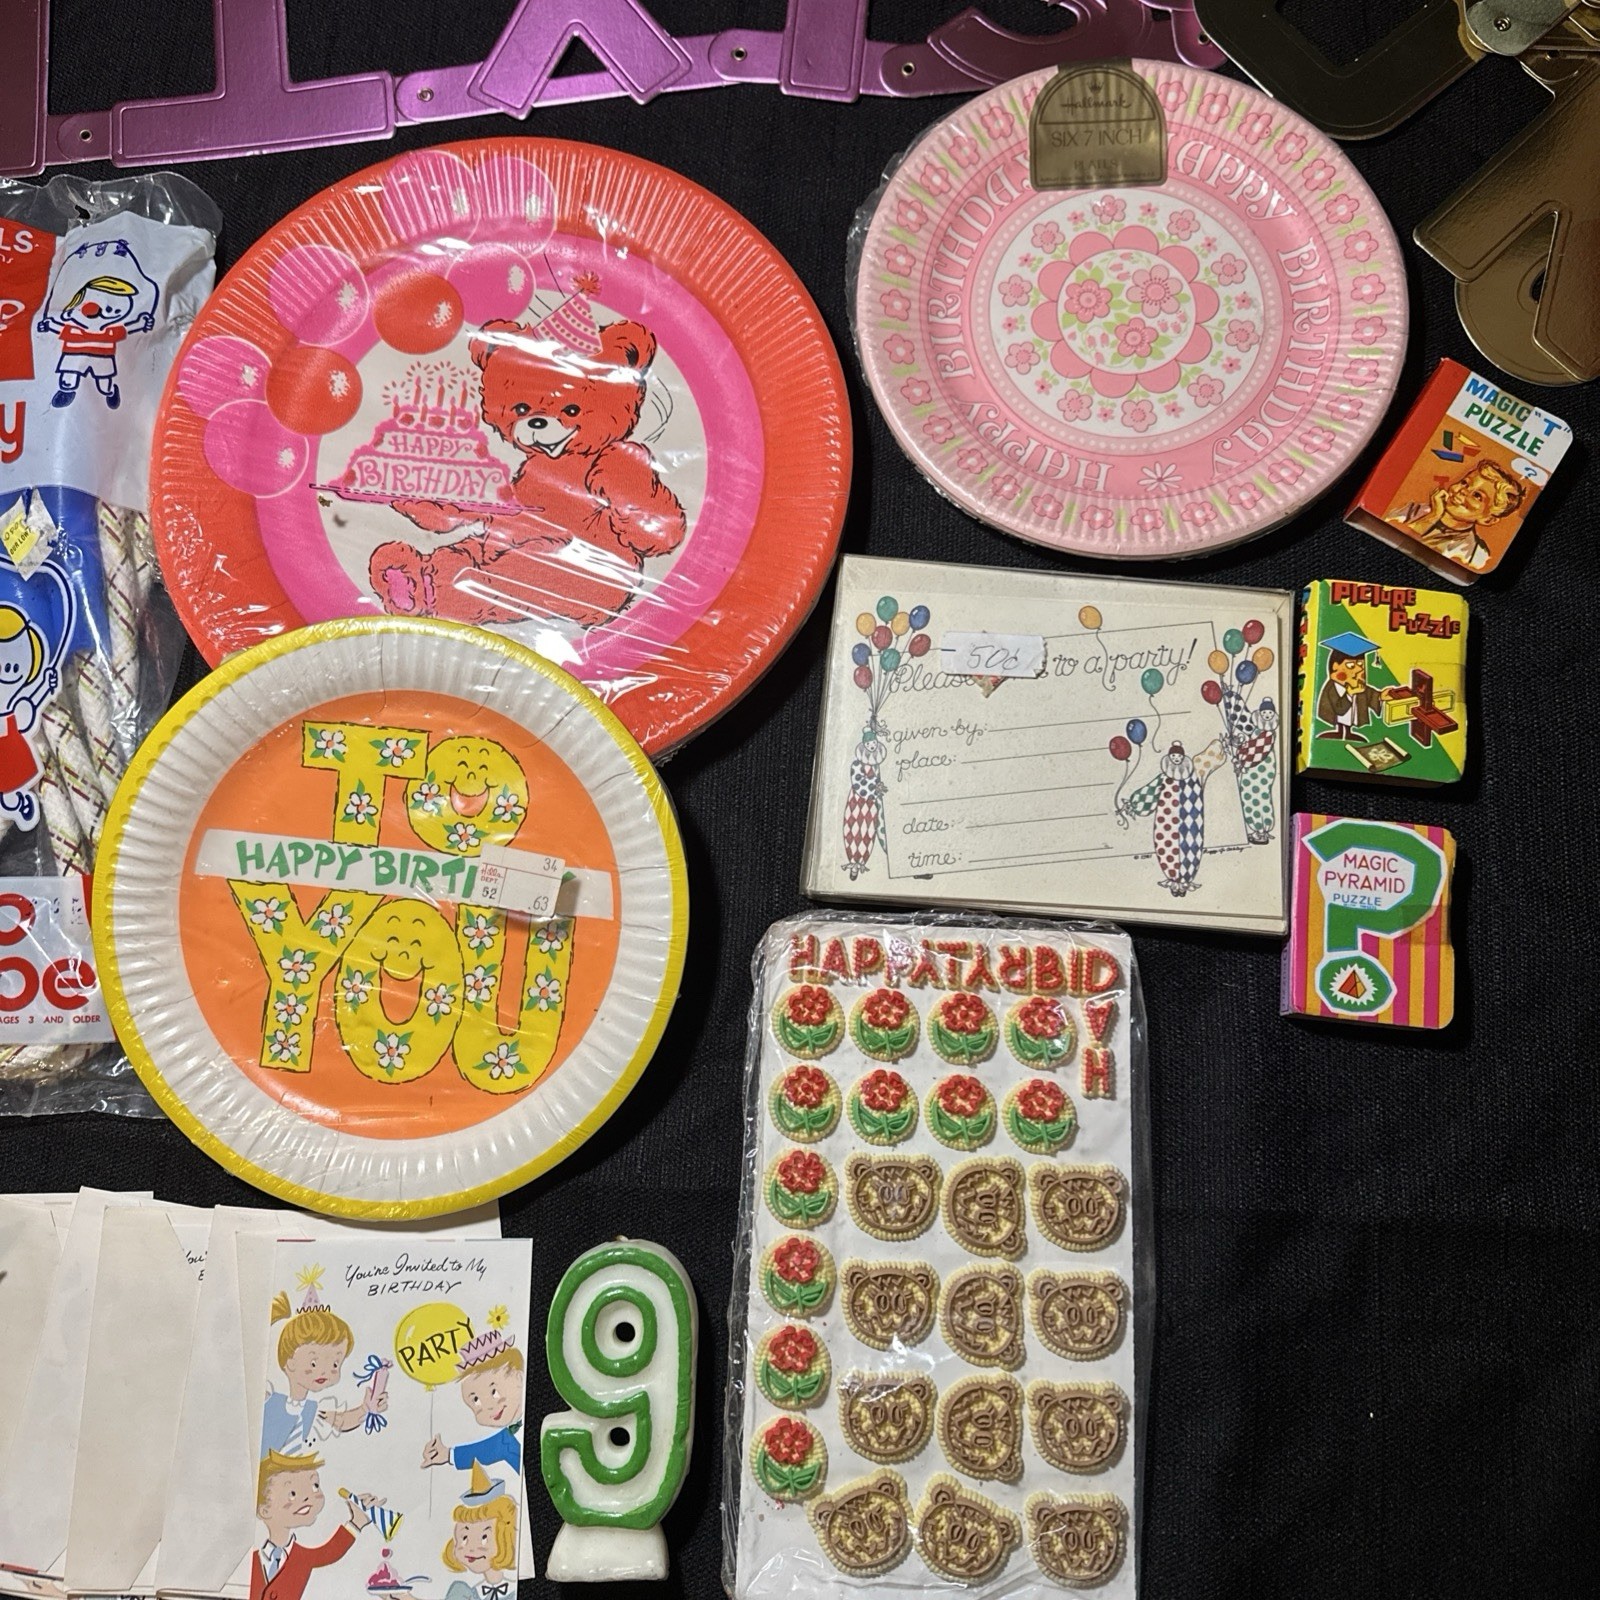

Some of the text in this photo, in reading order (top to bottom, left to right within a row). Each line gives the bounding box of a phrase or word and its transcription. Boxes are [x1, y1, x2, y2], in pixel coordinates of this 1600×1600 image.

[1061, 94, 1131, 115] Hallmark
[1051, 129, 1142, 147] SIX 7 INCH
[1167, 131, 1331, 479] APPY BIRTHDAY
[1465, 377, 1531, 421] MAGIC
[1464, 402, 1544, 457] PUZZLE
[388, 435, 474, 457] HAPPY
[953, 401, 1113, 494] HAPPY
[355, 459, 502, 498] BIRTHDAY
[1053, 655, 1080, 678] to
[1084, 657, 1104, 676] a
[1108, 638, 1198, 685] party!
[893, 724, 950, 752] given
[896, 751, 957, 781] place:
[302, 720, 529, 857] TO
[902, 816, 955, 835] date:
[235, 841, 363, 880] HAPPY
[543, 857, 557, 872] 34
[908, 849, 962, 868] time:
[1344, 853, 1398, 873] MAGIC
[480, 876, 498, 884] DEPT
[1325, 871, 1405, 893] PYRAMID
[482, 886, 497, 900] 52
[528, 896, 549, 911] .63
[1333, 893, 1381, 906] PUZZLE
[227, 879, 576, 1094] YOU
[28, 1016, 34, 1024] 3
[44, 1016, 63, 1024] AND
[73, 1015, 101, 1023] OLDER
[345, 1253, 487, 1288] You're Invited to My
[367, 1281, 462, 1296] BIRTHDAY
[398, 1317, 474, 1373] PARTY
[541, 1240, 698, 1530] 9
